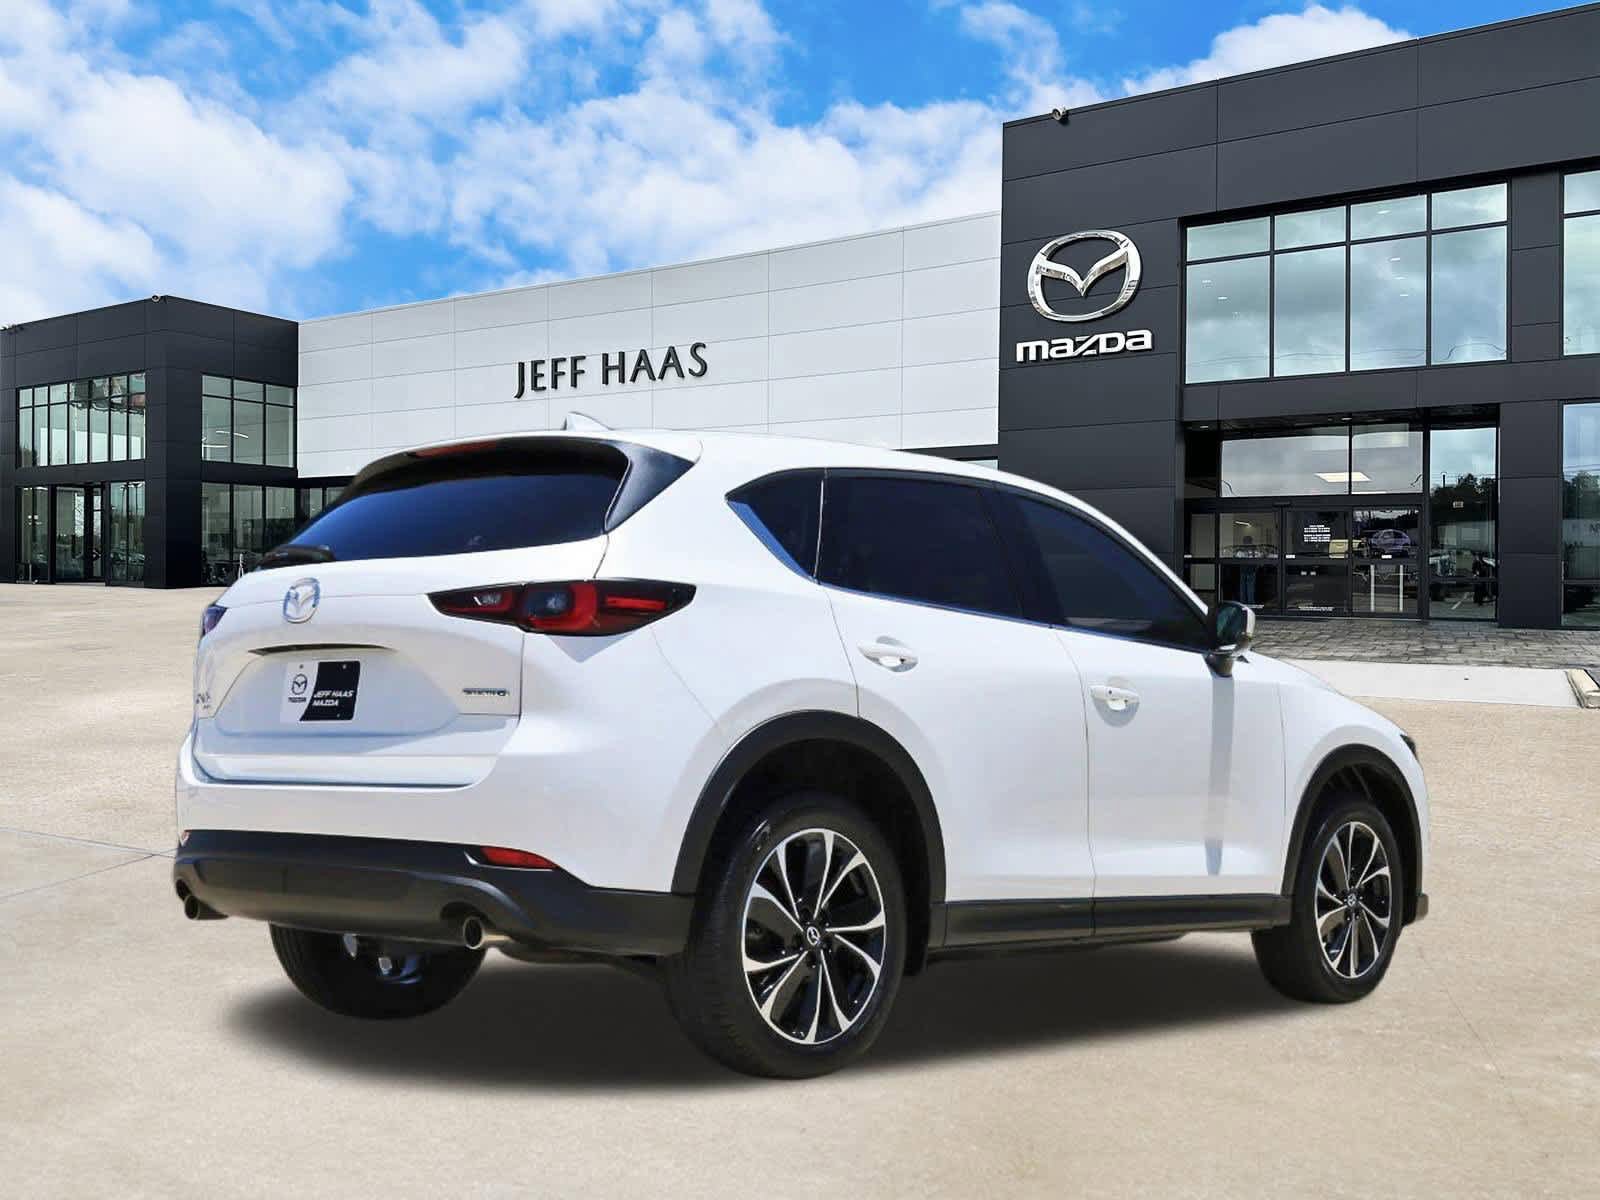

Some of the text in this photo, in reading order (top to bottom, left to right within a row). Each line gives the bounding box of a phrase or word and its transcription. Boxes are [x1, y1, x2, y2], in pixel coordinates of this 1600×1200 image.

[514, 342, 708, 399] JEFF HAAS
[314, 690, 332, 698] JEFF
